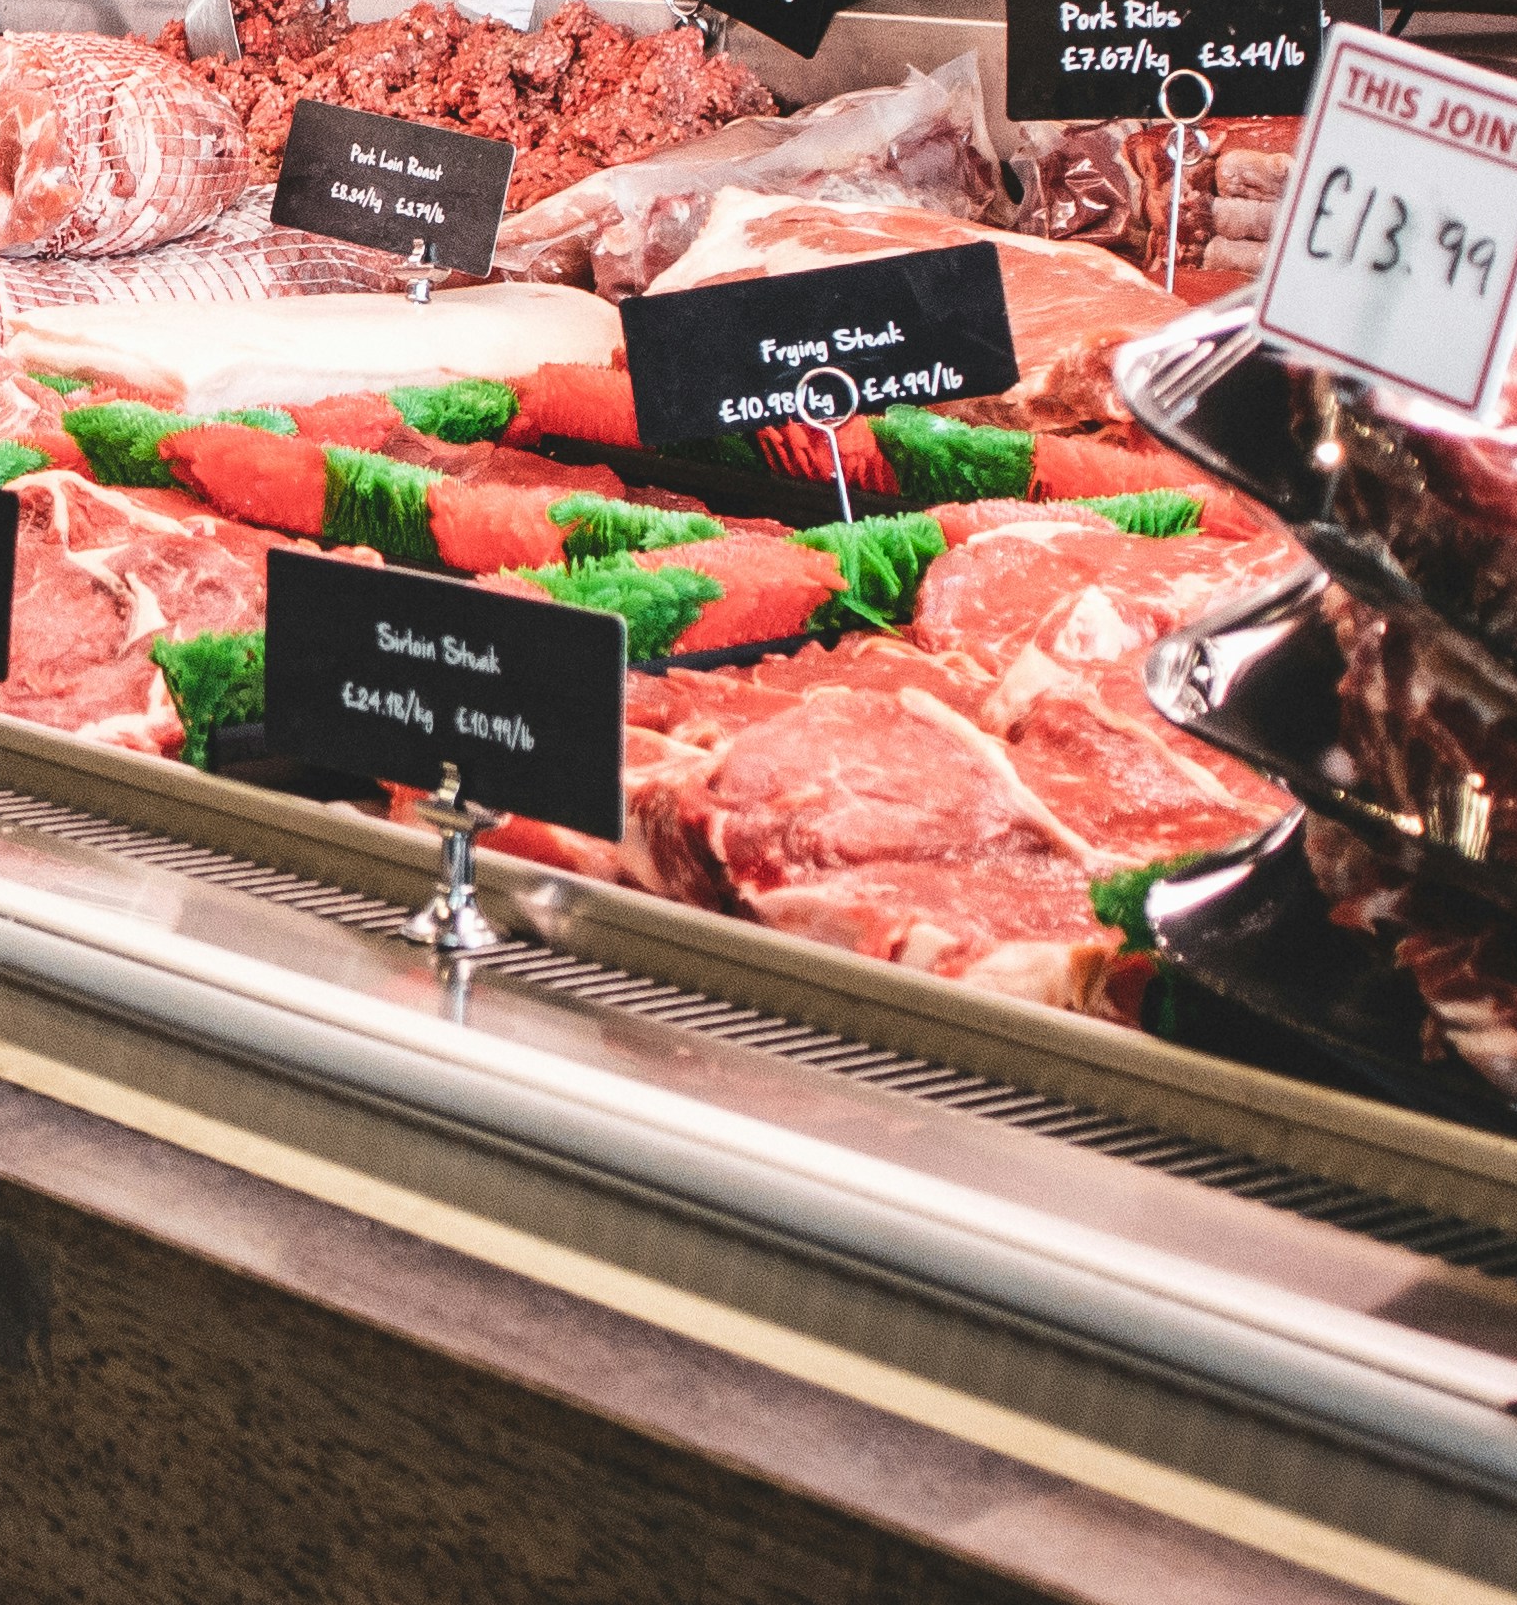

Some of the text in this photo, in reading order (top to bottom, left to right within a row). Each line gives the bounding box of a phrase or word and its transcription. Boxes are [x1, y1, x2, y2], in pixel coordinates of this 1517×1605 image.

[1060, 0, 1118, 33] Pork
[1060, 33, 1306, 78] £7.67/kg £3.49/lb
[1347, 66, 1423, 120] THIS
[350, 142, 444, 182] Pork Loin Roast
[330, 181, 446, 224] £8.34/kg £3.79/lb
[1306, 165, 1497, 297] £13.99
[759, 320, 906, 367] Frying Steak
[718, 361, 965, 424] £10.98/kg £4.99/lb
[375, 620, 503, 676] Sirloin Steak
[341, 680, 536, 753] £24.18/kg £10.99/lb
